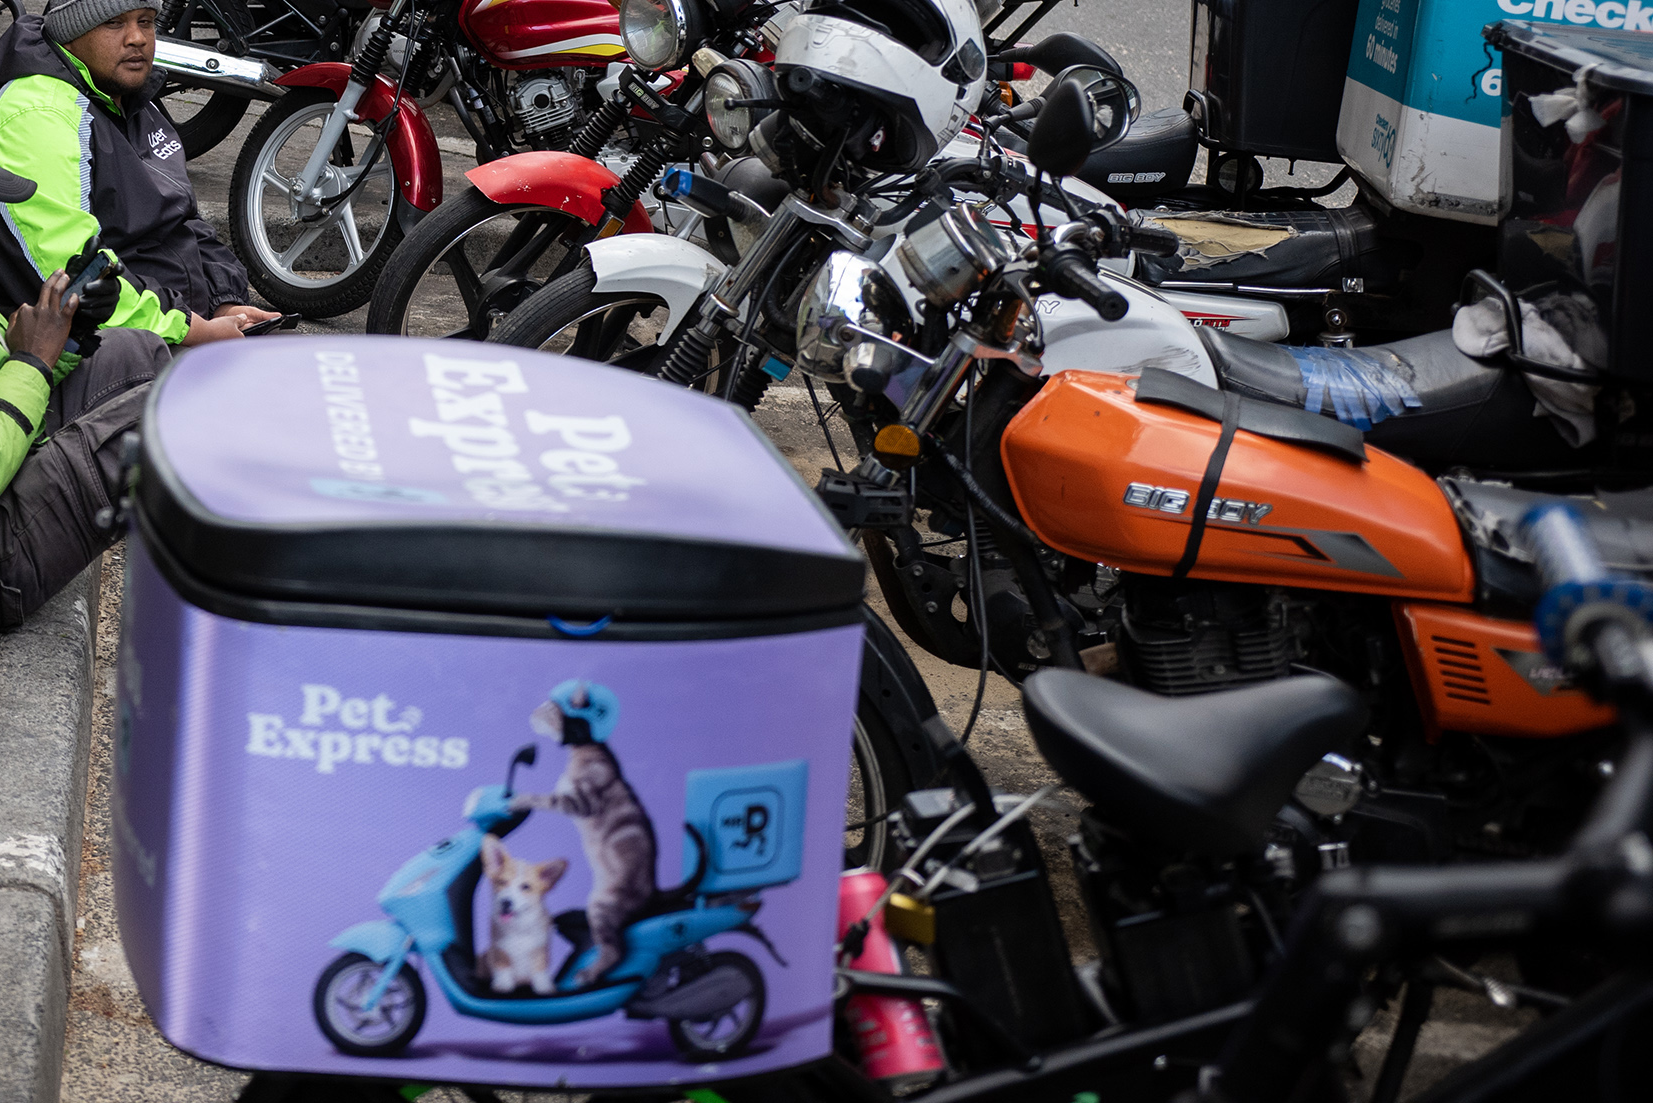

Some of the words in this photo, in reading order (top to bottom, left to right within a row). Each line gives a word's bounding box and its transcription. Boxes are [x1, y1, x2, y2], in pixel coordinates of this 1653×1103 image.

[1373, 39, 1398, 74] minutes
[1481, 68, 1502, 96] 6
[147, 127, 168, 148] Uber
[152, 140, 182, 160] Eats
[1107, 172, 1135, 183] BIG
[1134, 171, 1166, 183] BOY
[314, 350, 378, 462] DELIVERED
[523, 408, 646, 494] Pet
[1122, 481, 1190, 515] BIG
[300, 682, 413, 734] Pet
[246, 711, 470, 775] Express
